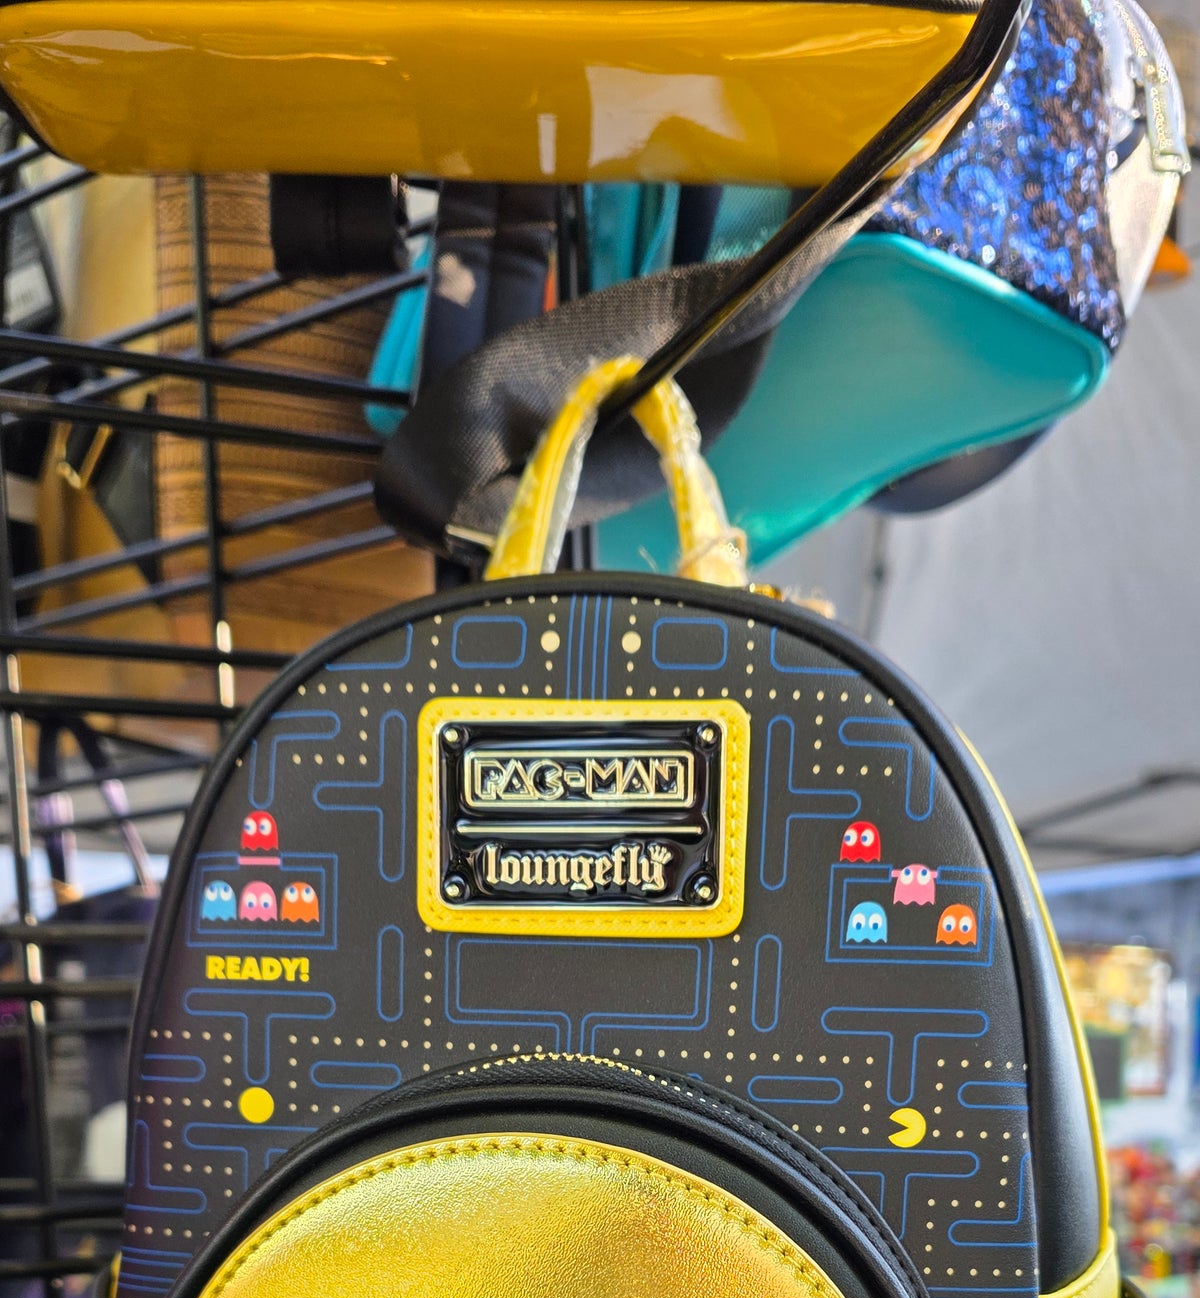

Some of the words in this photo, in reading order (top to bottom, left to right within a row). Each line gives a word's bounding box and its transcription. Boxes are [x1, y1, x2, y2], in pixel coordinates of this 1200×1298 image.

[474, 757, 684, 801] PAC-MAN
[485, 843, 671, 891] loungefly
[206, 955, 310, 982] READY!
